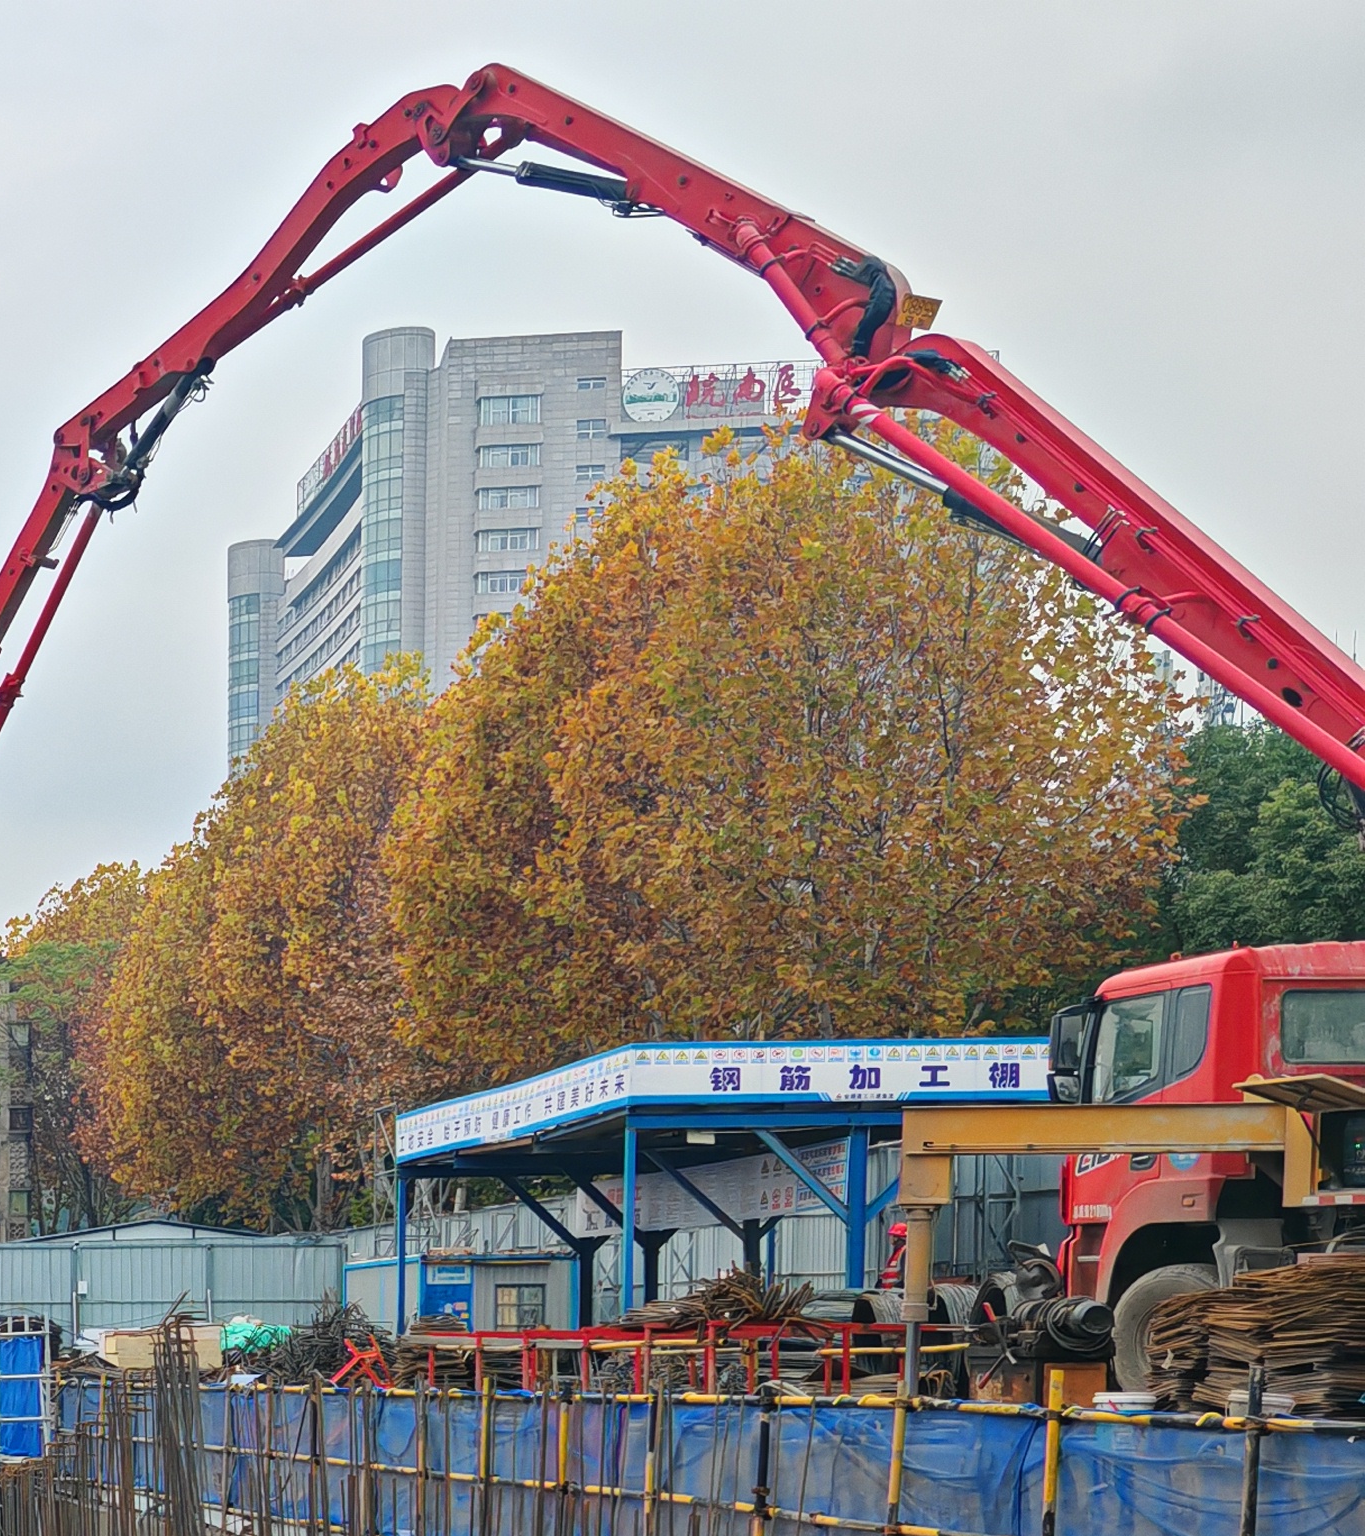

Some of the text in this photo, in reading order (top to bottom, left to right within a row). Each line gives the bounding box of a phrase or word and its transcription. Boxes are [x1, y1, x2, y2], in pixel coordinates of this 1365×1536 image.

[709, 1062, 1021, 1091] 钢筋加工棚
[544, 1074, 625, 1116] 共建美好未来
